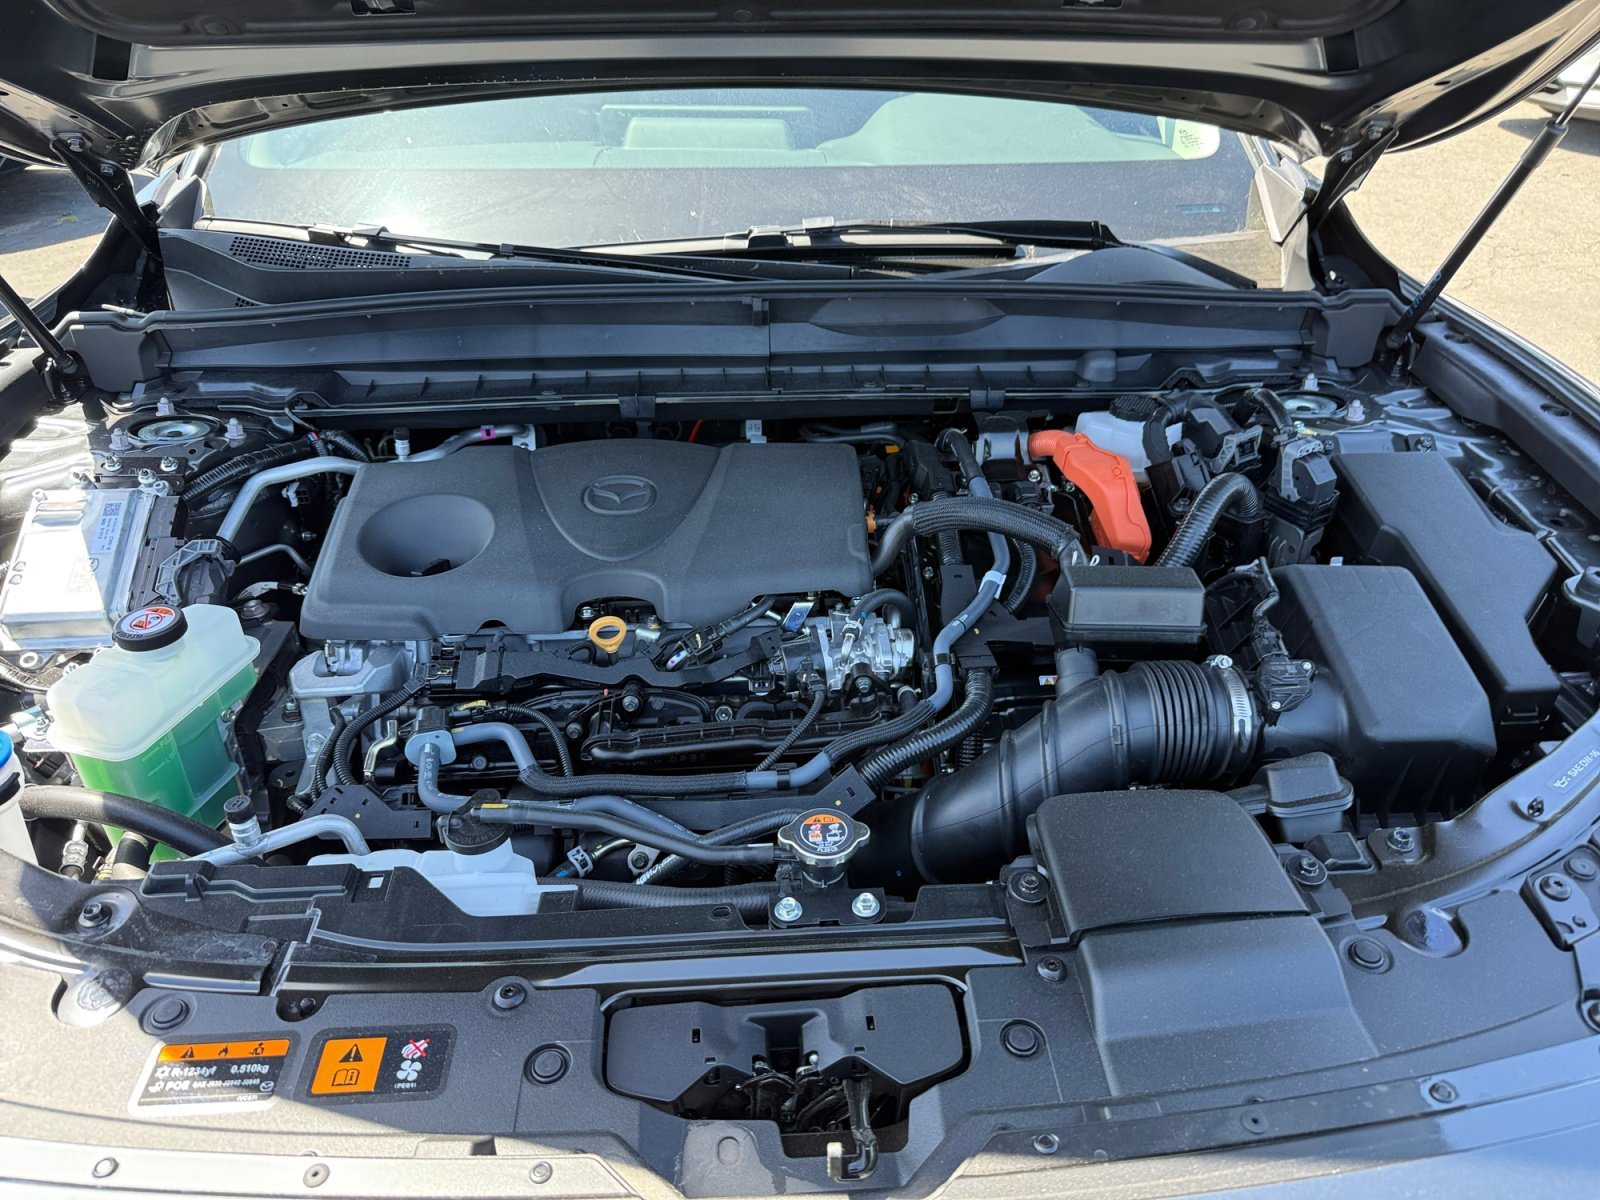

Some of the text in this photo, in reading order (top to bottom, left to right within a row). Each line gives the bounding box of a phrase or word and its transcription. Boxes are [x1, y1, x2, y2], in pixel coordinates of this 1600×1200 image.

[1567, 763, 1585, 777] SAE
[171, 1063, 270, 1078] R-1234yf 0.510kg
[165, 1080, 191, 1091] POE
